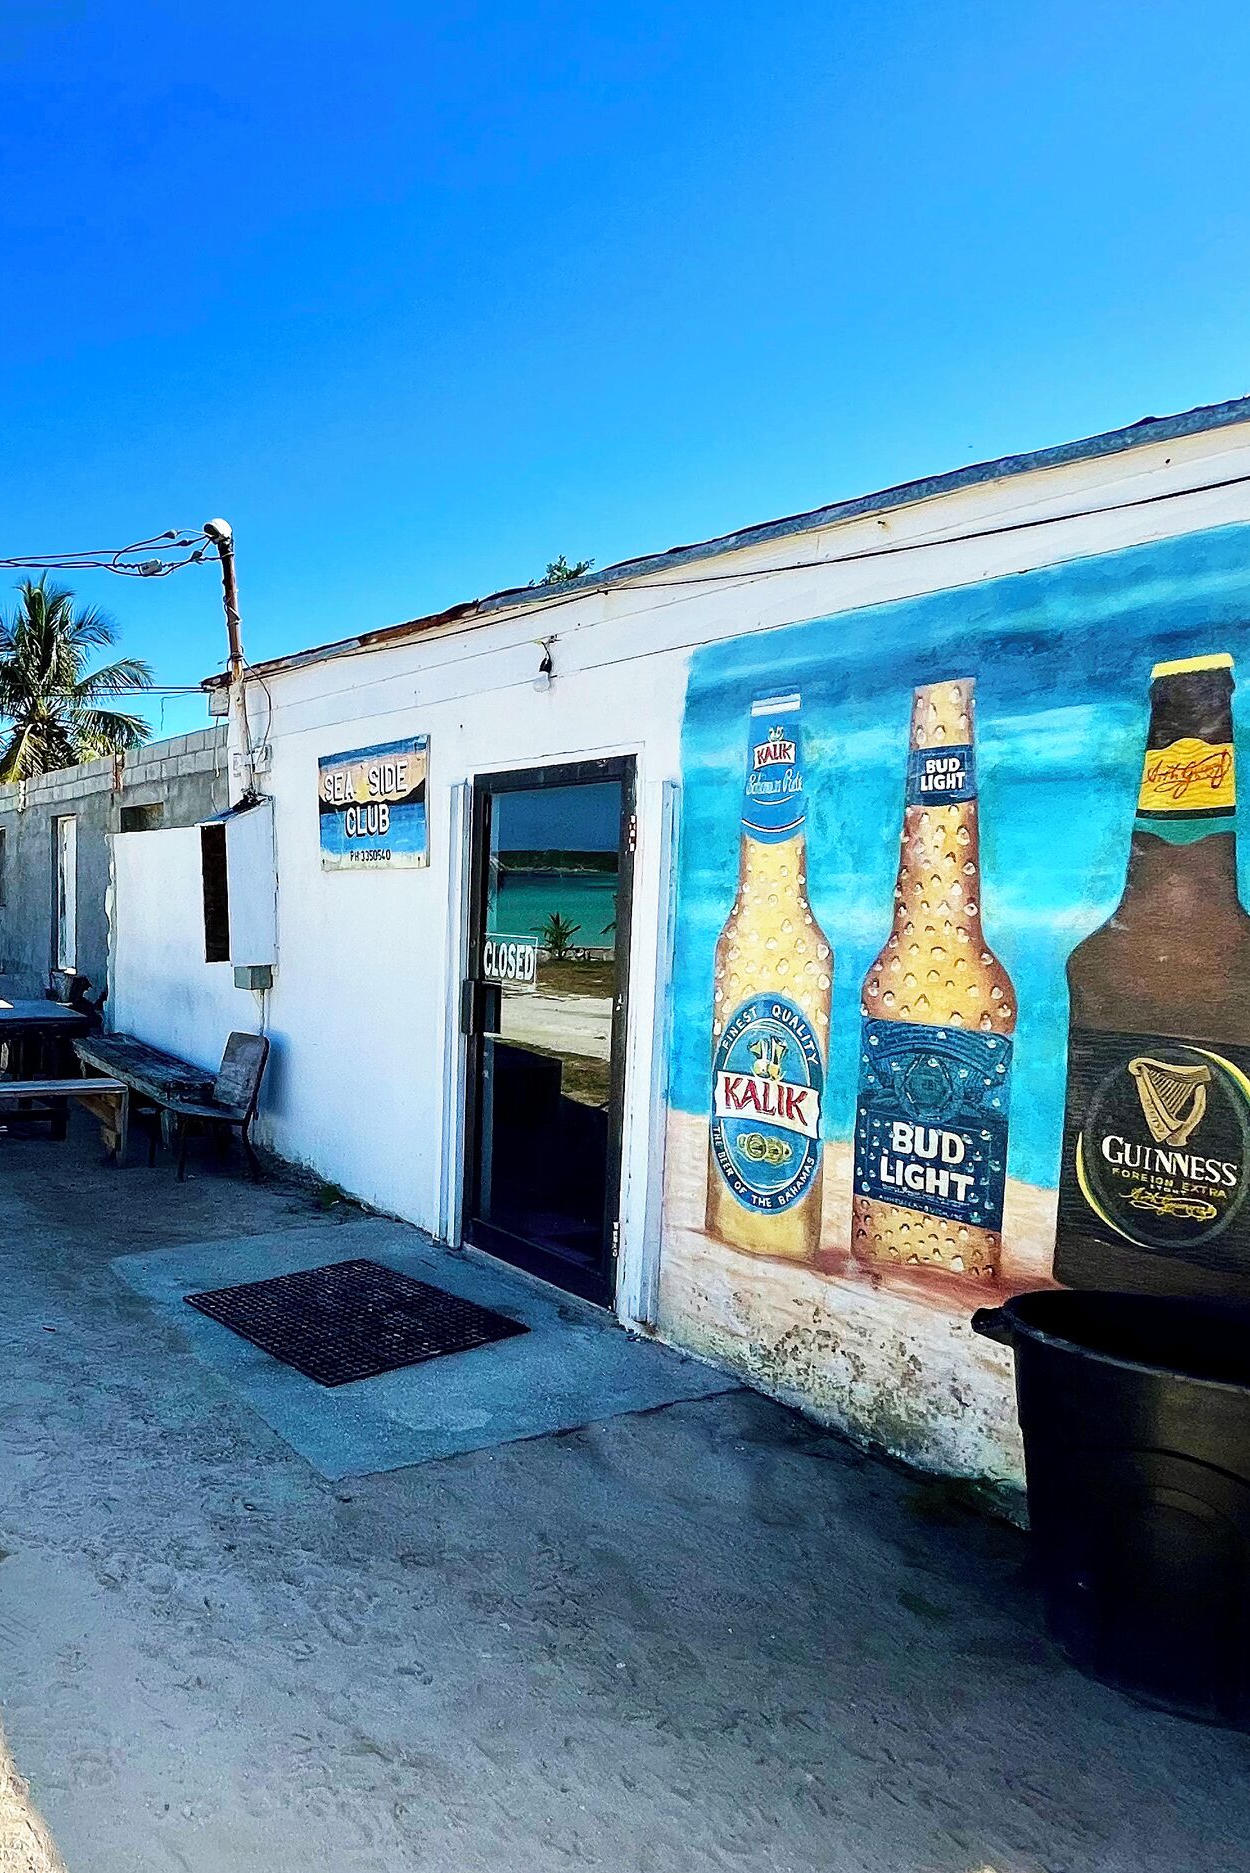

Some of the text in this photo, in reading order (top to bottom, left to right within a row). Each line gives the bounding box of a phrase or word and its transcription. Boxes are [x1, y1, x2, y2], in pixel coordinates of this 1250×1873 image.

[757, 743, 792, 765] KALIK
[926, 758, 960, 773] BUD
[324, 760, 408, 802] SEA SIDE
[921, 772, 965, 791] LIGHT
[345, 804, 390, 838] CLUB
[484, 941, 535, 981] CLOSED
[722, 1004, 819, 1065] FINEST QUALITY
[724, 1076, 808, 1126] KALIK
[892, 1121, 965, 1165] BUD
[1101, 1135, 1238, 1187] GUINNESS
[713, 1127, 815, 1208] THE BEER OF THE BAHAMAS
[880, 1155, 975, 1202] LIGHT
[1182, 1181, 1228, 1199] EXTRA
